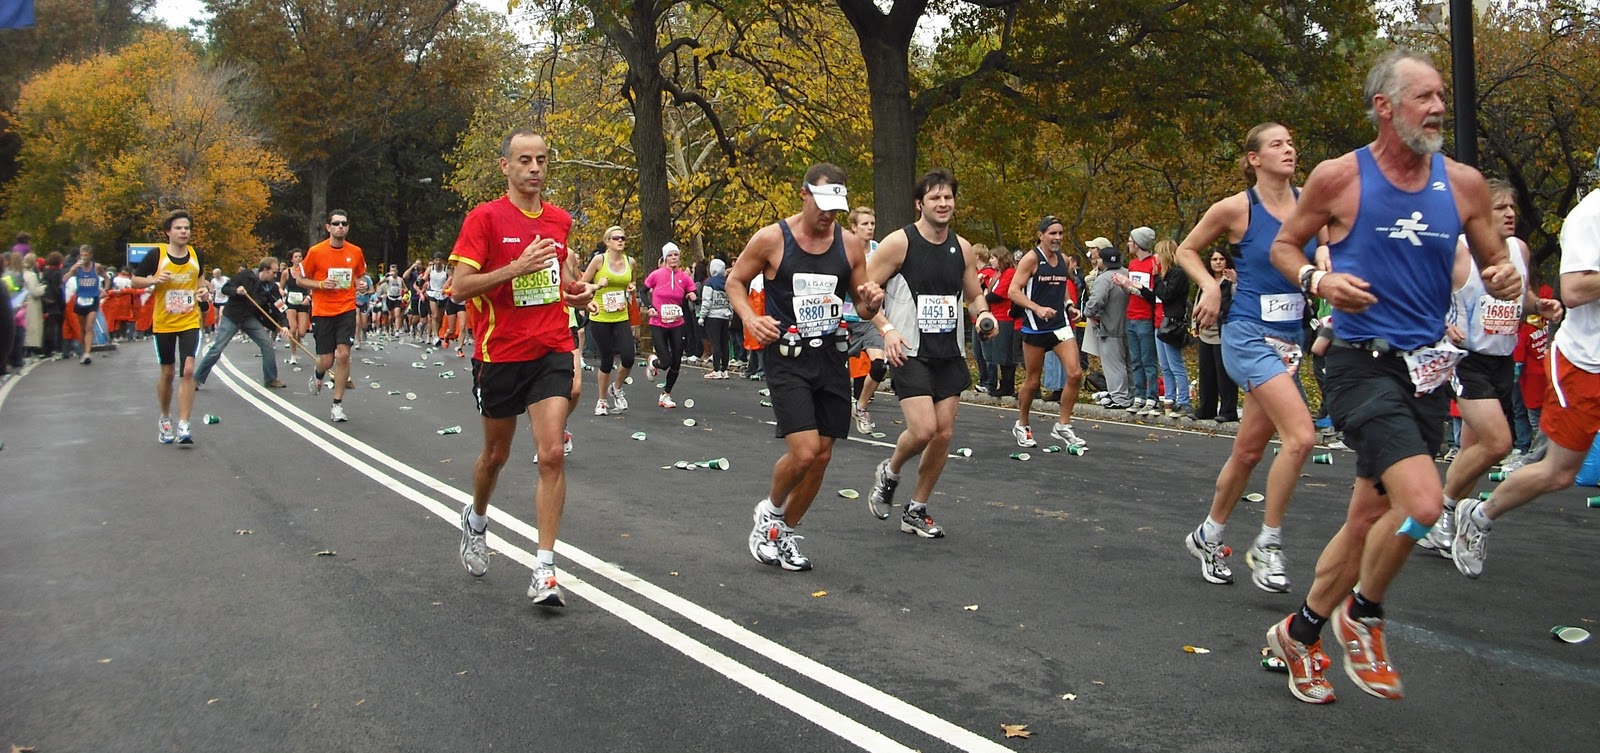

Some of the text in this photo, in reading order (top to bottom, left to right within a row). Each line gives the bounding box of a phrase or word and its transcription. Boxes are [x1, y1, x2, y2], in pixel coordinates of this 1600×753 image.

[346, 273, 351, 281] C
[514, 269, 557, 288] 38305 C
[187, 295, 193, 304] B
[801, 298, 820, 306] ING
[799, 304, 839, 321] 8880 D
[922, 305, 955, 318] 4454 B
[1268, 300, 1301, 314] Bart
[1486, 305, 1515, 319] 16869
